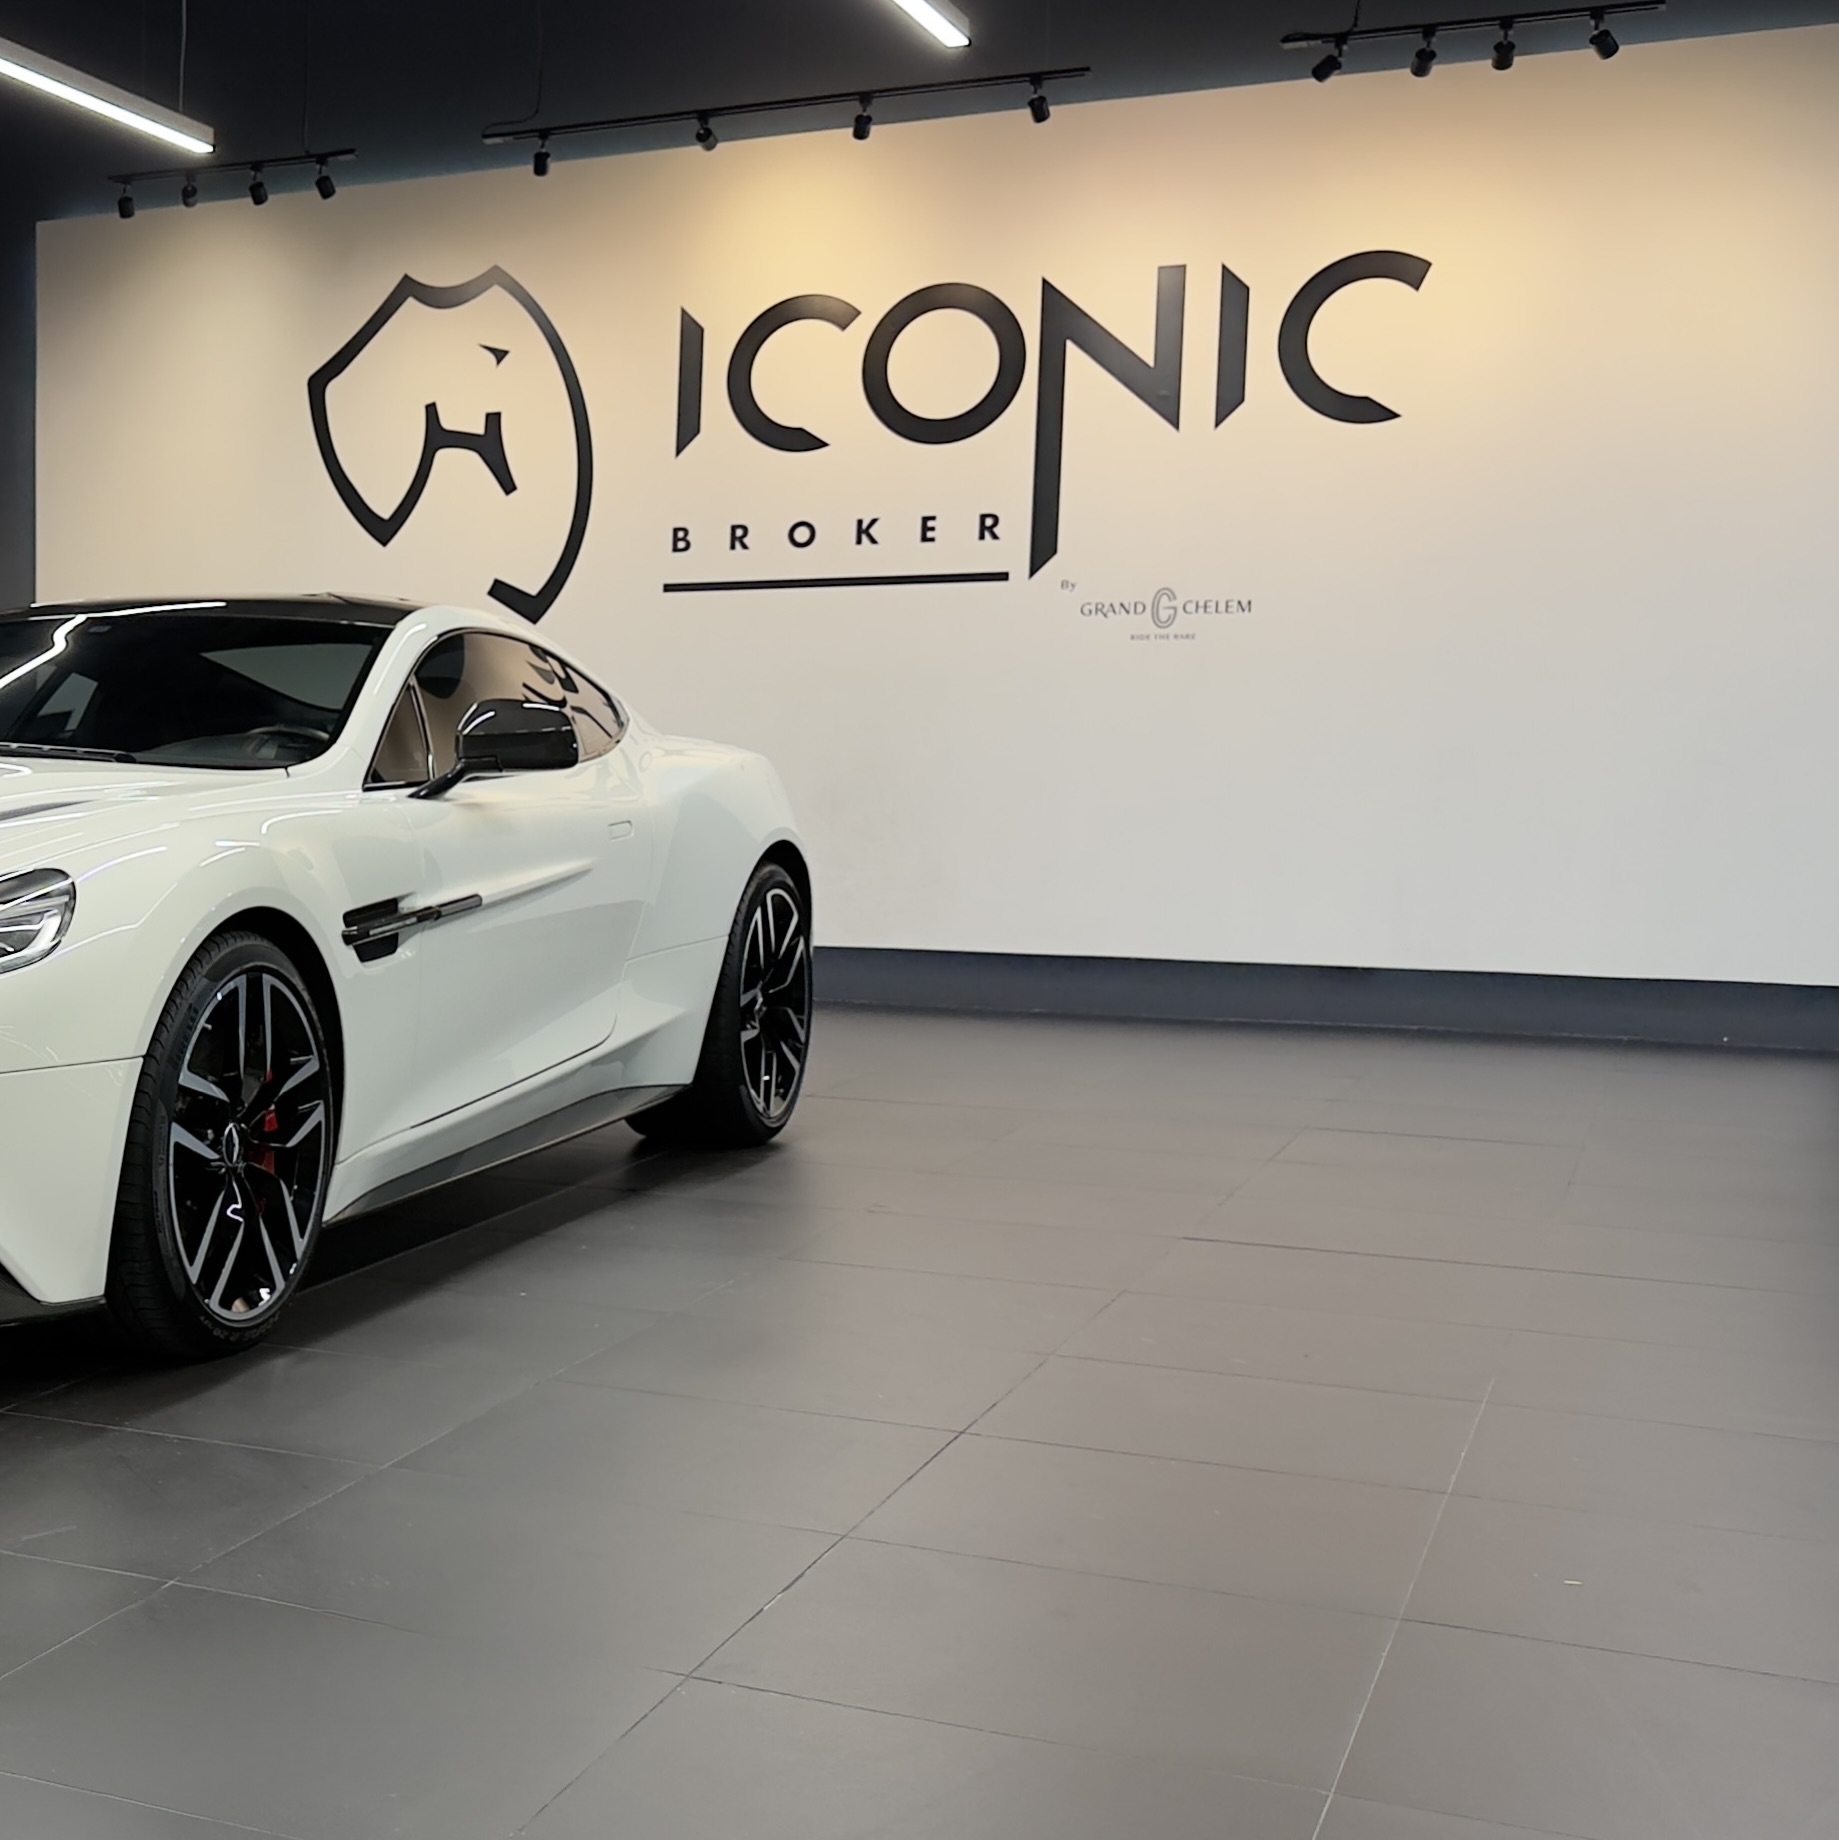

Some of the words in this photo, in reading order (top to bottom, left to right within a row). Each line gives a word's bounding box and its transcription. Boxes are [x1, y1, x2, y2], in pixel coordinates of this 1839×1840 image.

[675, 249, 1433, 580] ICONIC
[671, 513, 1000, 553] BROKER
[1060, 579, 1077, 592] By
[1079, 601, 1147, 618] GRAND
[1182, 599, 1252, 615] CHELEM
[1154, 633, 1170, 641] THE
